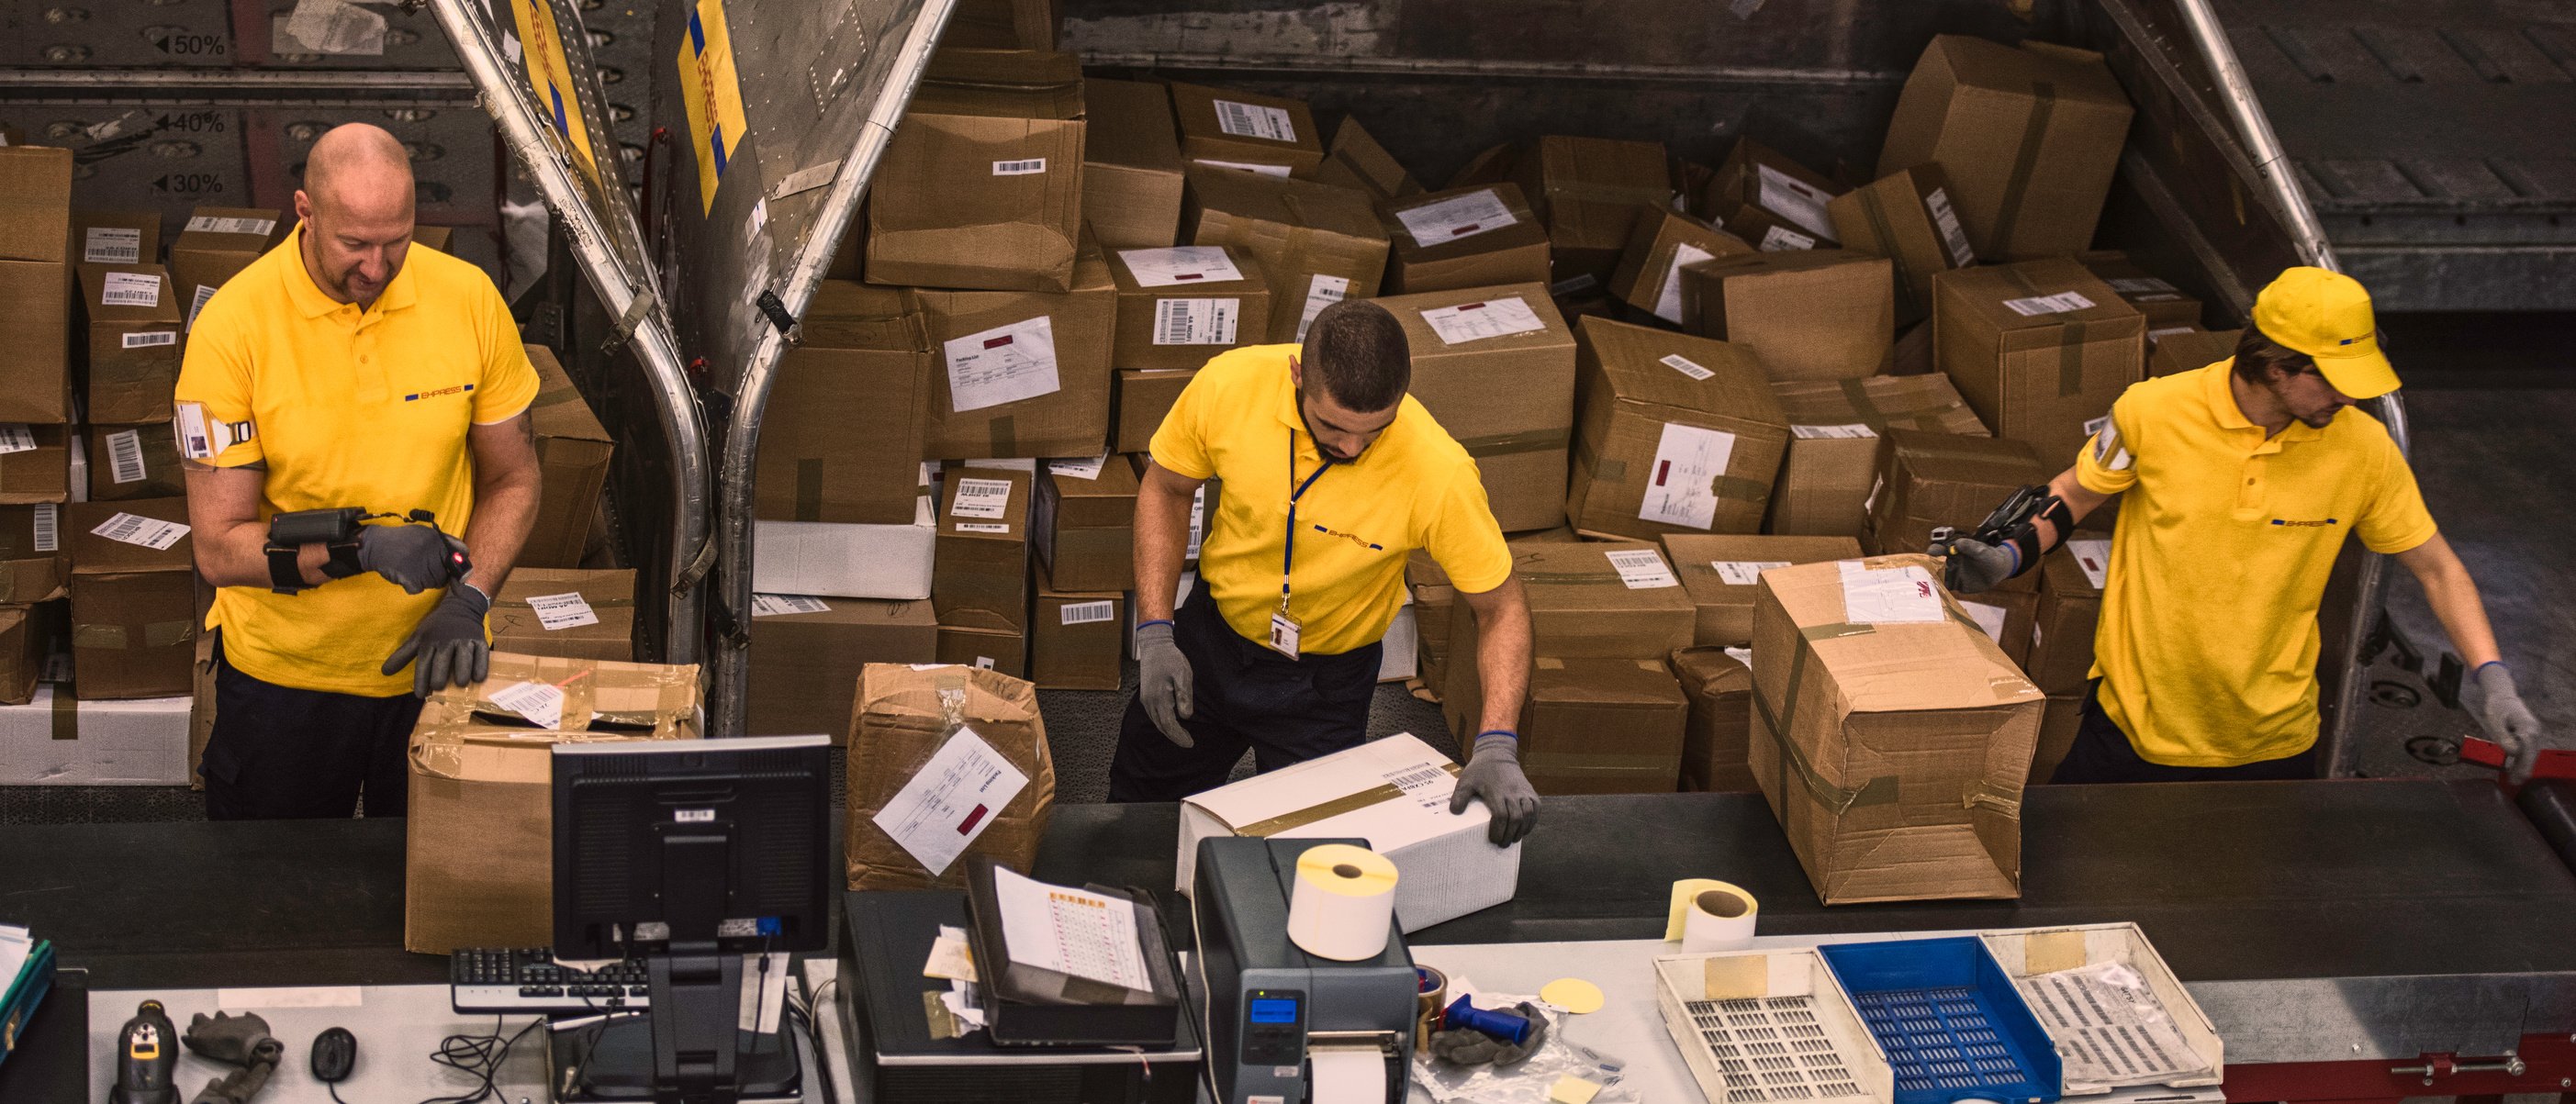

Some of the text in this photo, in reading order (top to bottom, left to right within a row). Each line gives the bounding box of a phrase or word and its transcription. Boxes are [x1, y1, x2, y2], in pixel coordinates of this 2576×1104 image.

[174, 35, 225, 55] 50%
[698, 50, 718, 133] EXPRESS
[174, 113, 225, 133] 40%
[173, 173, 223, 193] 30%
[420, 385, 462, 399] EXPRESS
[1328, 530, 1369, 548] EXPRESS
[979, 769, 1002, 793] Packing List
